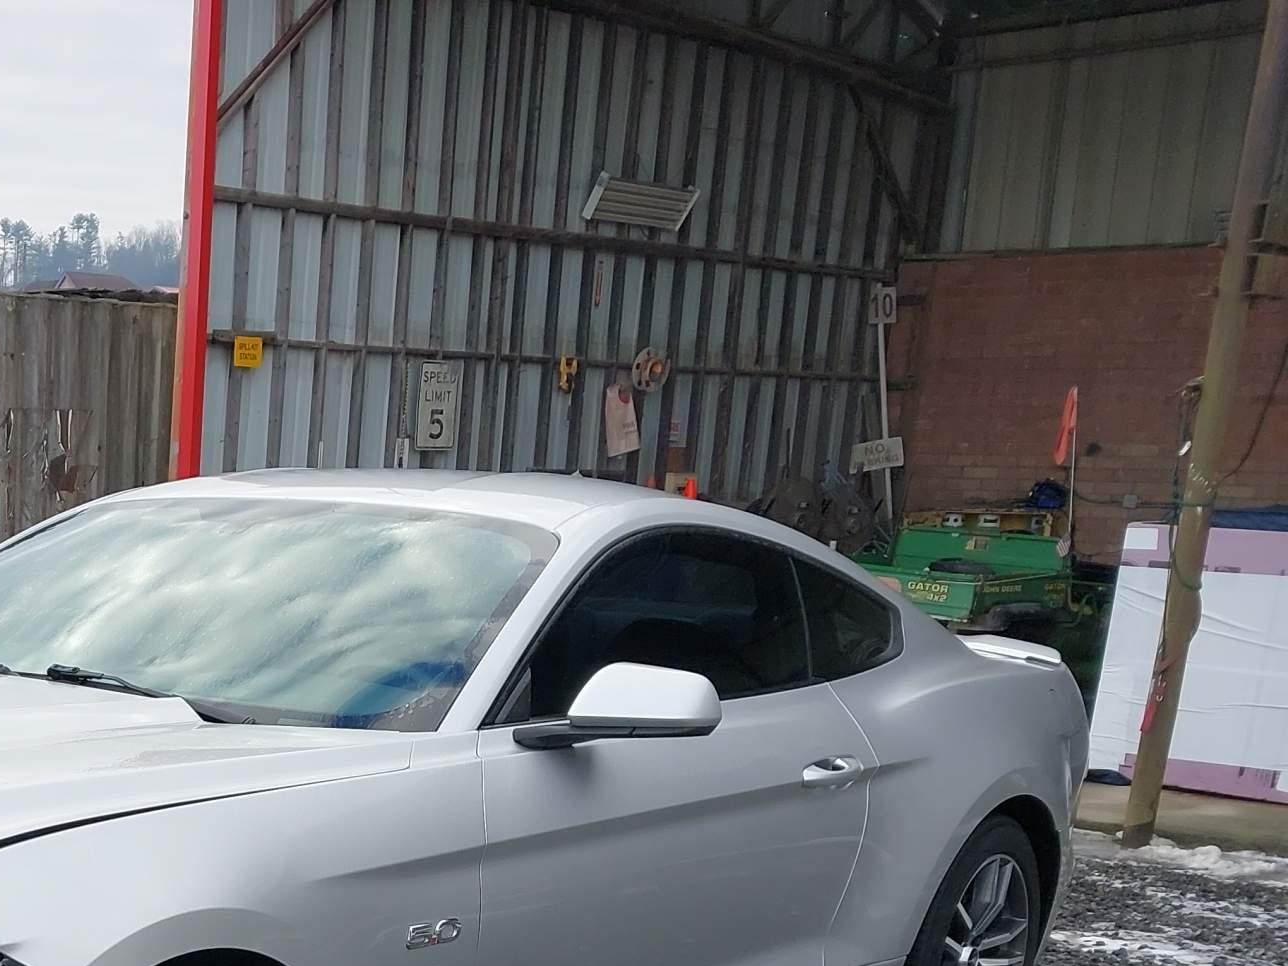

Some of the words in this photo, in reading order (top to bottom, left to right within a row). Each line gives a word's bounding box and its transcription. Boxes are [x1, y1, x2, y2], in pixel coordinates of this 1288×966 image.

[872, 293, 893, 318] 10
[423, 370, 457, 384] SPEED
[425, 390, 452, 403] LIMIT
[428, 408, 444, 440] 5
[864, 443, 885, 456] NO
[907, 581, 949, 593] GATOR
[406, 918, 462, 950] 5.0
